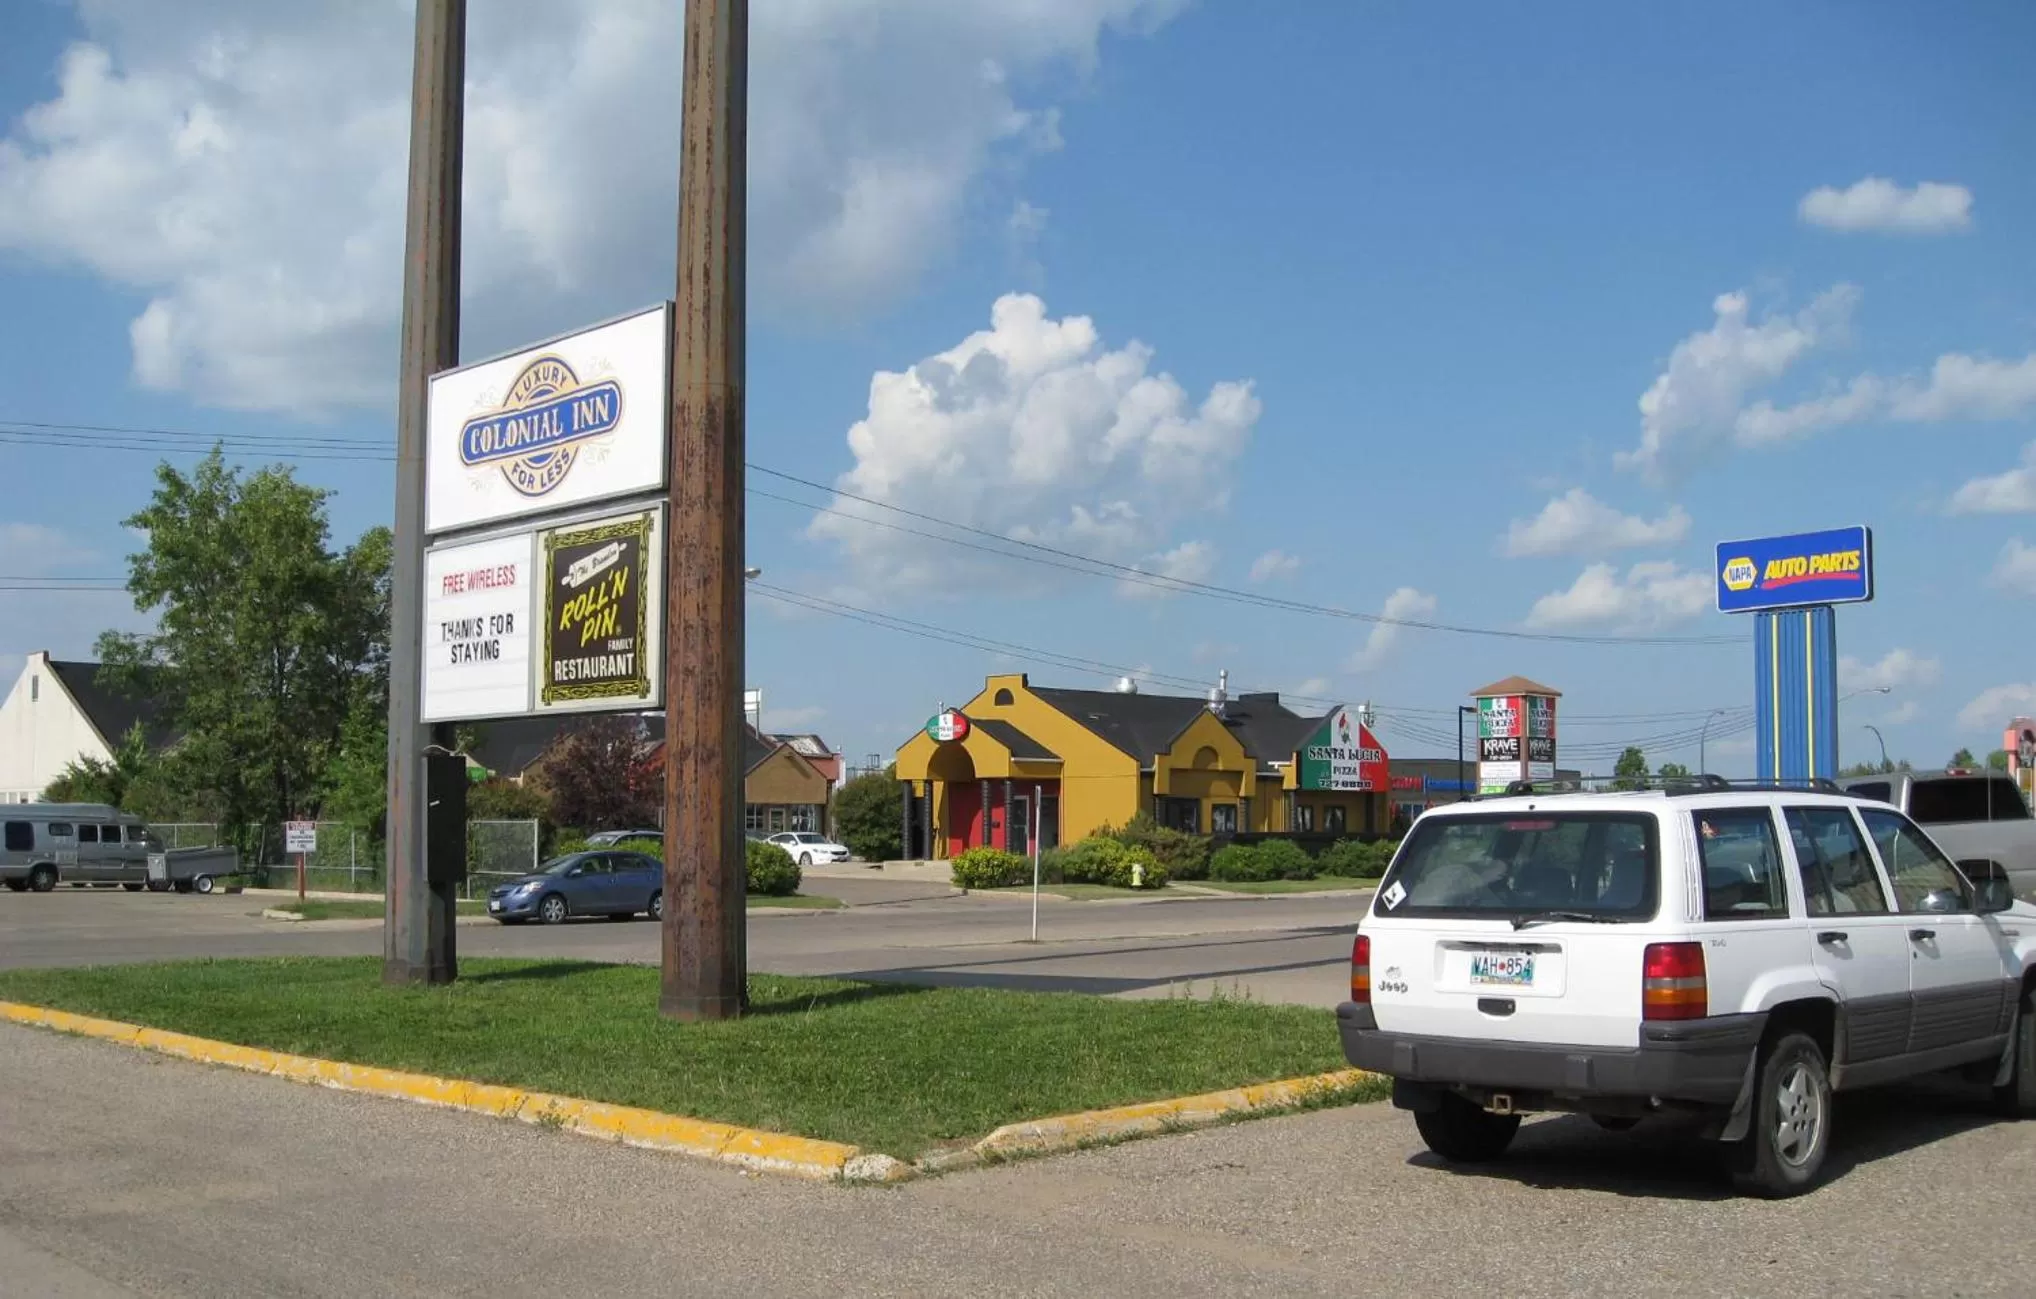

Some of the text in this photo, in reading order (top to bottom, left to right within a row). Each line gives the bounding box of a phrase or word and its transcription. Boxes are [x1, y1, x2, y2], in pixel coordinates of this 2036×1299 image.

[516, 365, 568, 402] LUXURY
[470, 393, 610, 455] COLONIAL INN
[511, 447, 570, 489] FOR LESS
[1728, 565, 1752, 582] NAPA
[1763, 550, 1861, 580] AUTO PARTS
[443, 564, 516, 596] FREE WIRELESS
[559, 566, 629, 631] ROLL'N
[441, 613, 514, 642] THANKS FOR
[580, 604, 617, 648] PIN
[451, 639, 500, 664] STAYING
[608, 637, 634, 651] FAMILY
[555, 653, 634, 681] RESTAURANT
[1308, 747, 1381, 762] SANTA LUCIA
[1484, 738, 1518, 756] KRAVE
[1333, 766, 1357, 776] PIZZA
[1507, 957, 1532, 976] 854
[1378, 980, 1409, 994] Jeep
